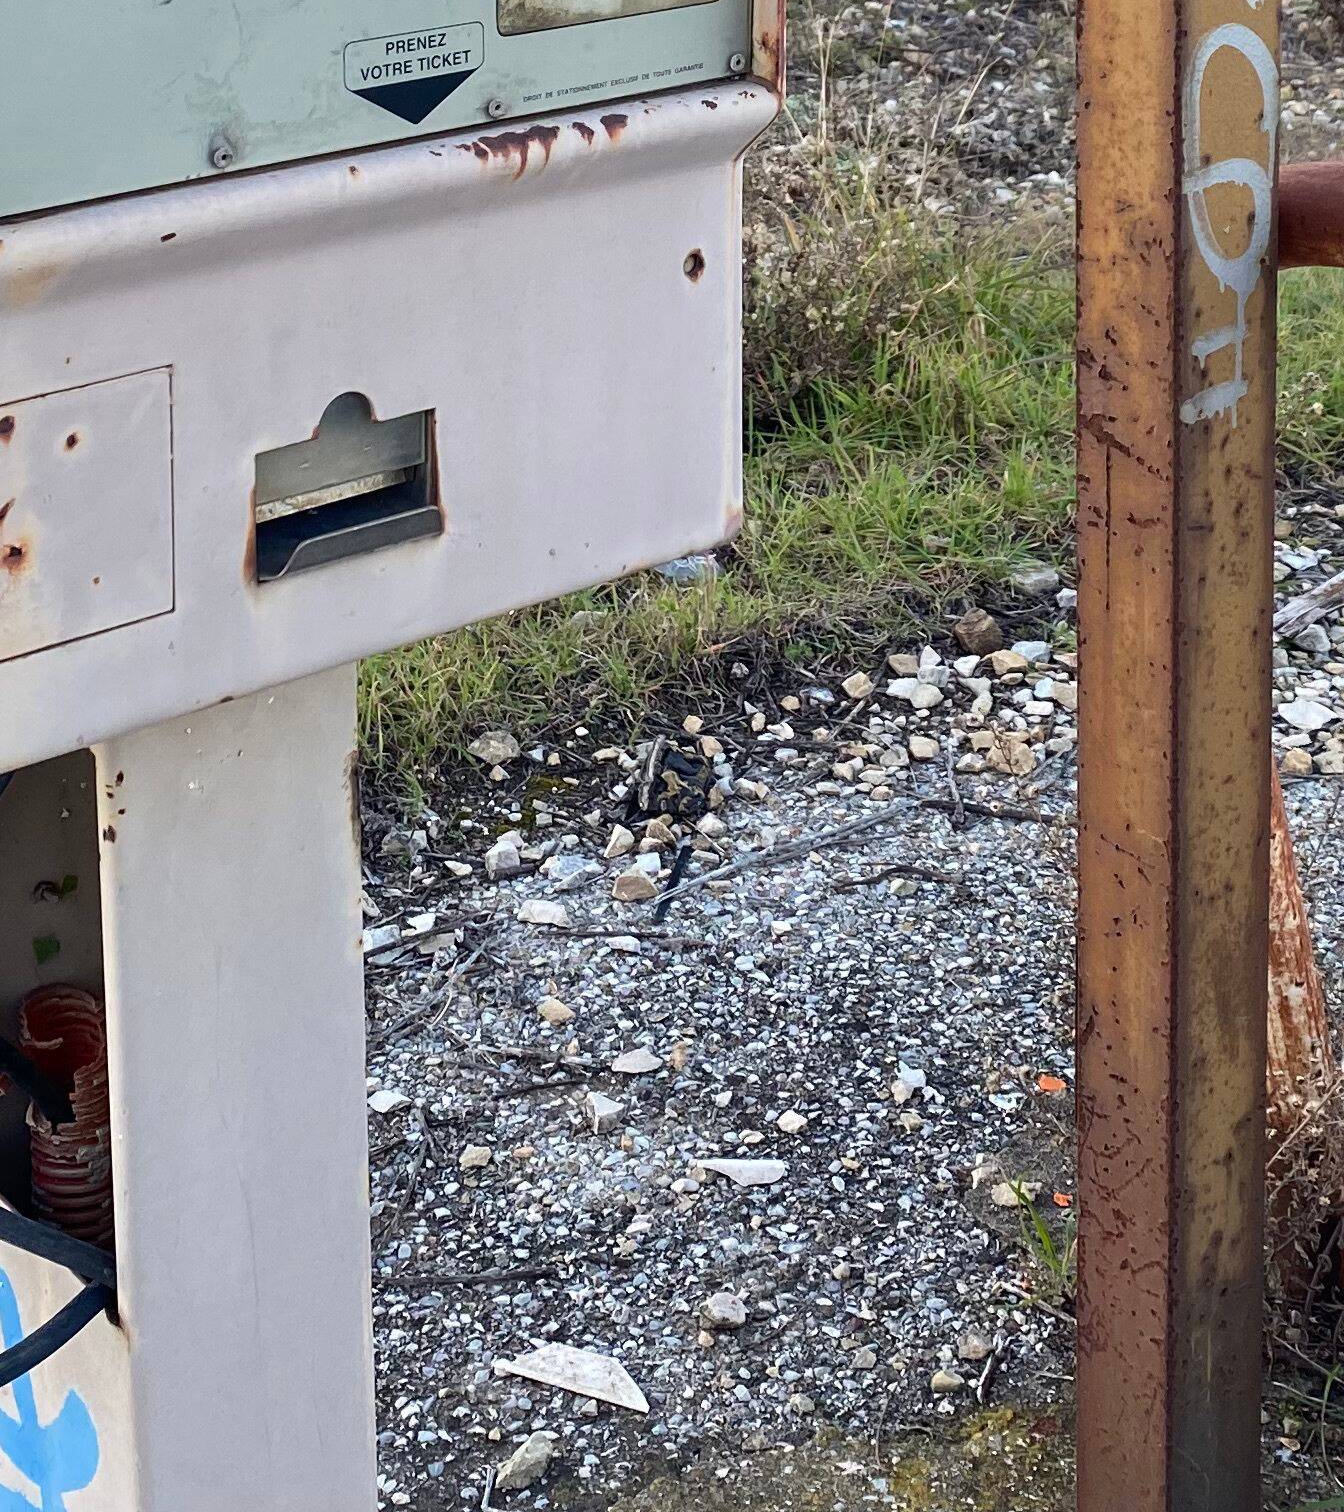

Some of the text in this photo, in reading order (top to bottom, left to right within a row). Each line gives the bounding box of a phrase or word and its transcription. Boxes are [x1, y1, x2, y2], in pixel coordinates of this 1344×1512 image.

[386, 33, 447, 56] PRENEZ
[360, 50, 471, 81] VOTRE TICKET
